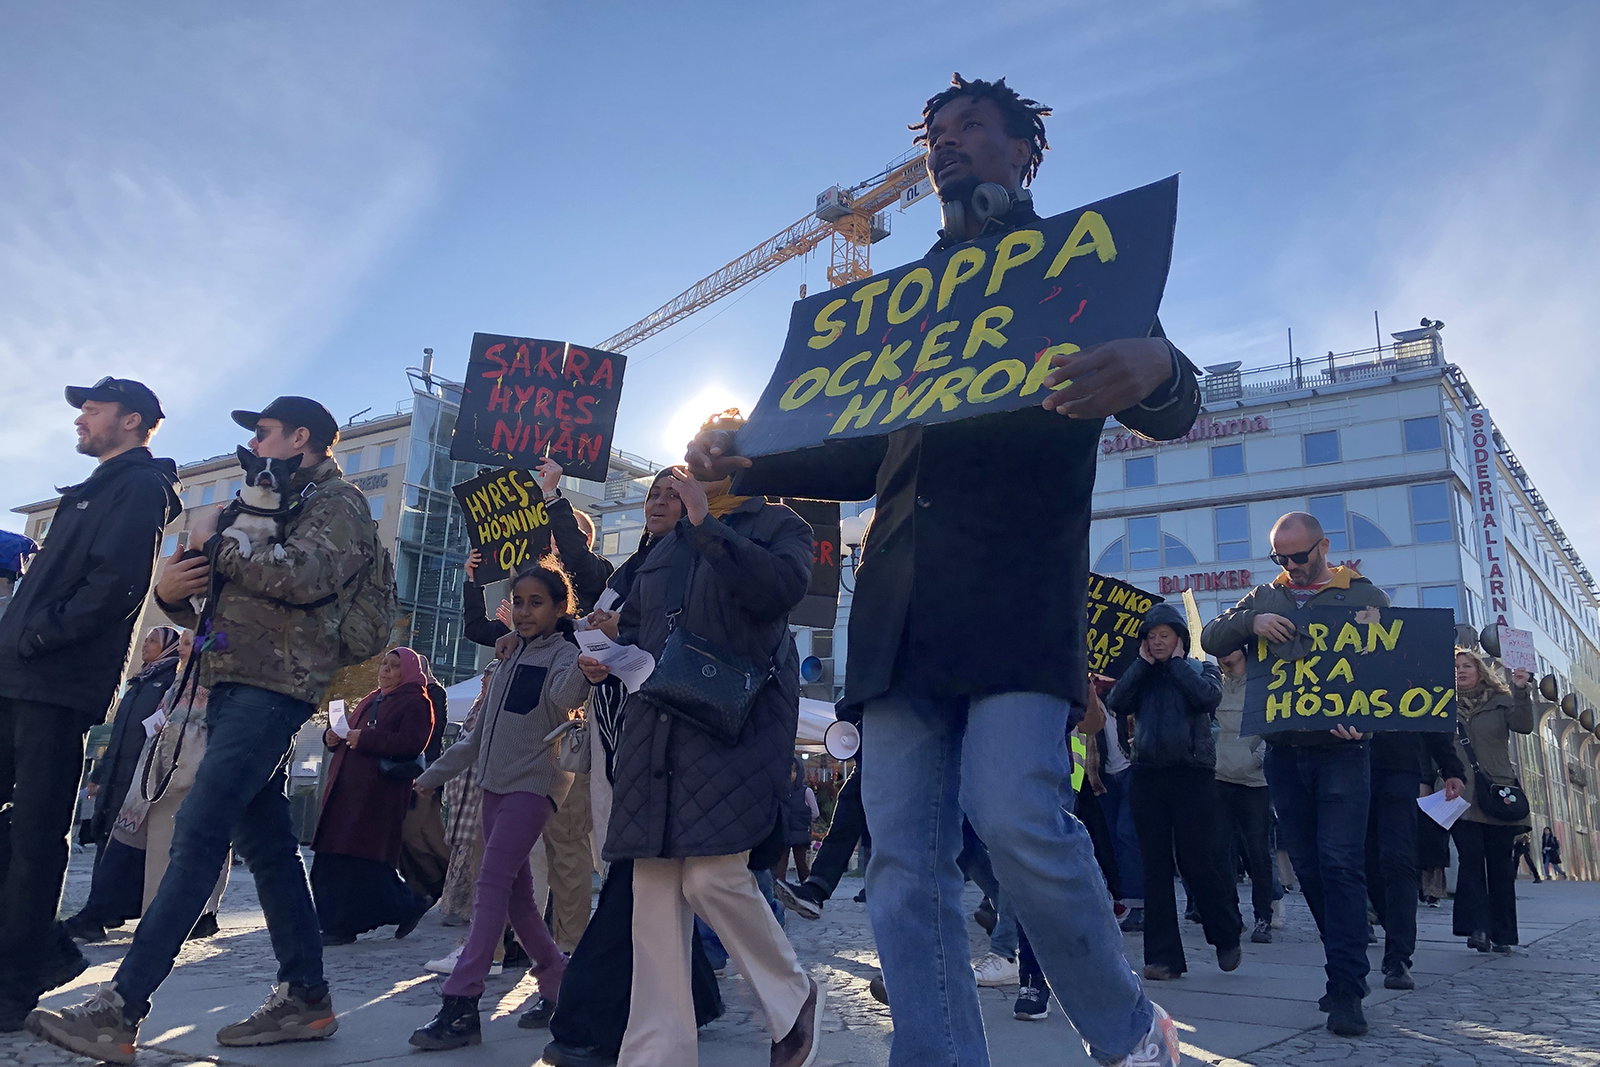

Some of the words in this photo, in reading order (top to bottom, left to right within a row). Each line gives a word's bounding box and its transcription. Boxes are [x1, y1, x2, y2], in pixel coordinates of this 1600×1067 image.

[808, 210, 1118, 350] STOPPA
[481, 339, 614, 390] SÄKRA
[779, 305, 1014, 412] OCKER
[487, 384, 597, 425] HYRES
[491, 419, 603, 462] NIVÅN
[465, 470, 535, 523] HYRES-
[477, 501, 550, 546] HÖJNING
[1470, 412, 1509, 627] SÖDERHALLARNA
[499, 538, 531, 571] 0%
[1158, 568, 1251, 595] BUTIKER
[1266, 655, 1355, 691] SKA
[1265, 686, 1393, 723] HÖJAS
[1399, 686, 1454, 719] 0%
